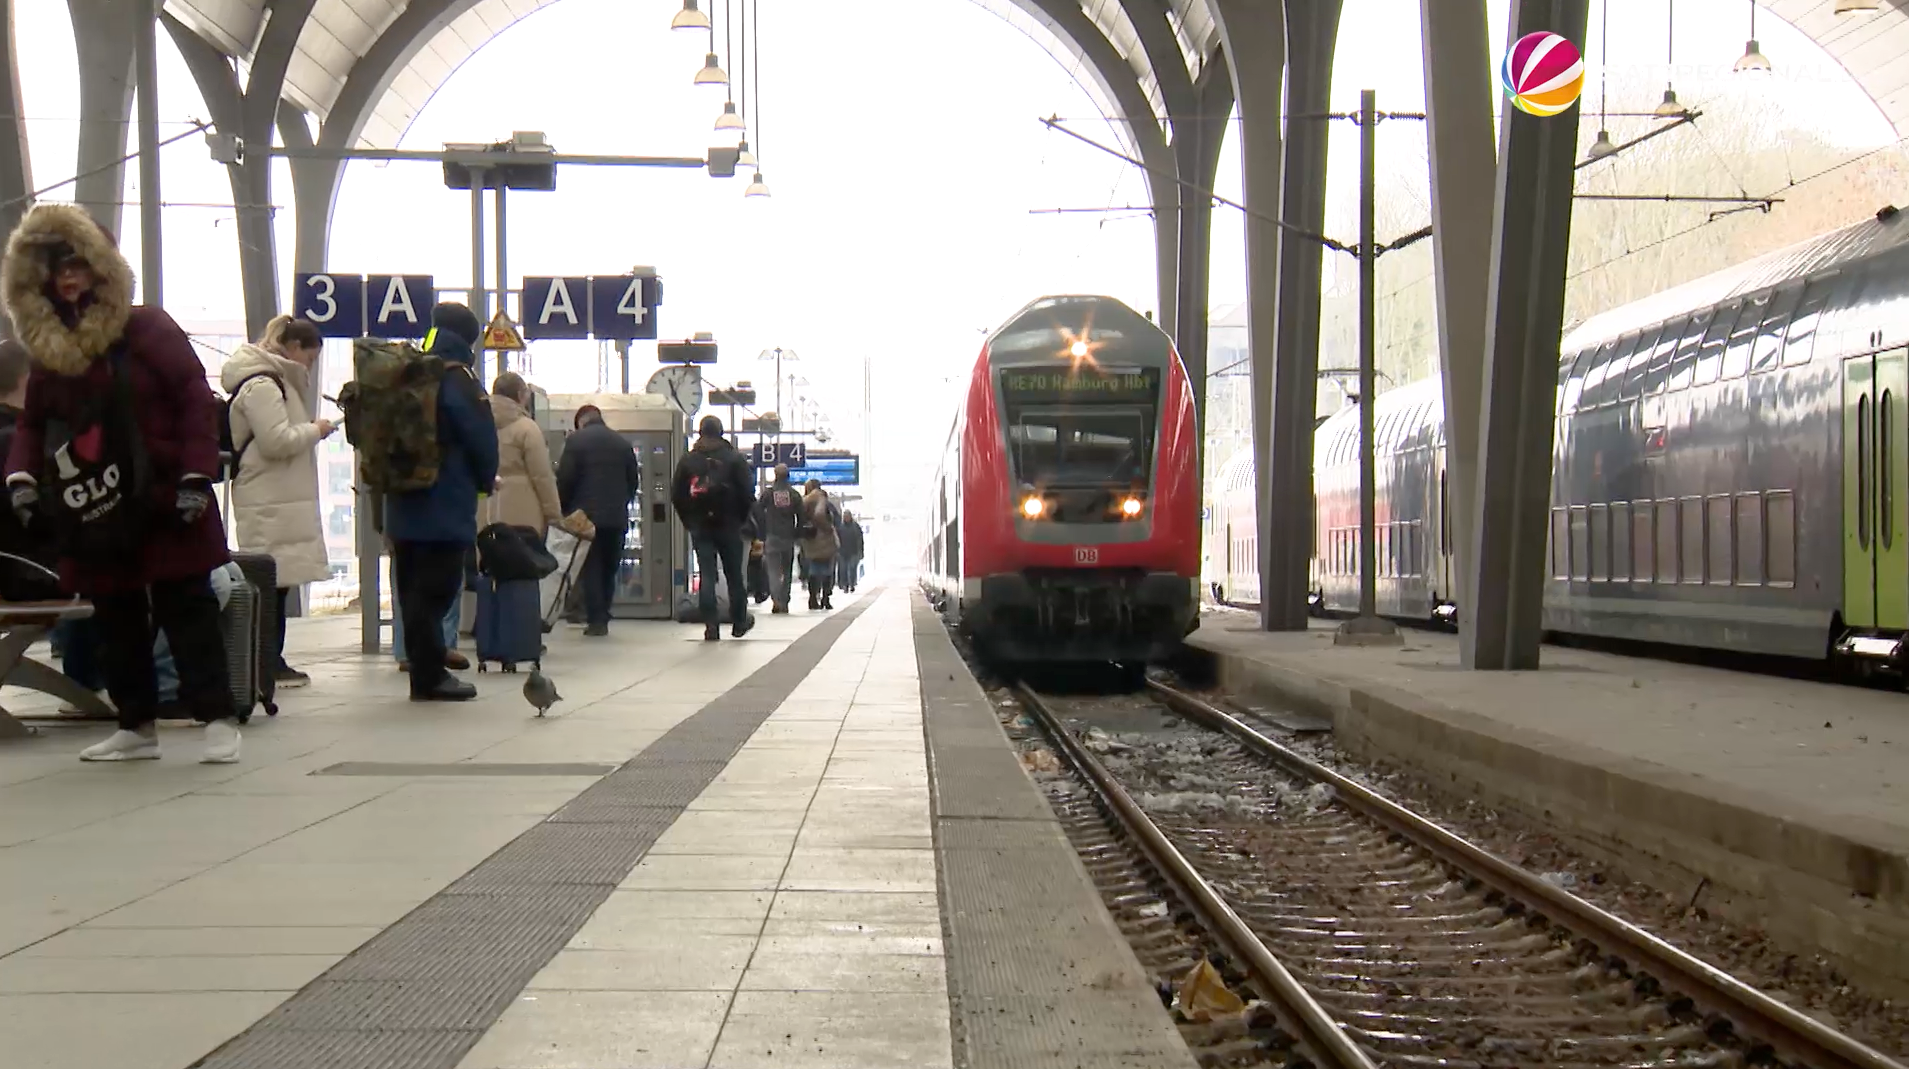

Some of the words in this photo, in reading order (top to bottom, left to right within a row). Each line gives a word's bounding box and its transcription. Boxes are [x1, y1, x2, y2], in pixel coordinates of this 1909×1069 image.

[305, 274, 338, 322] 3
[377, 275, 418, 323] A
[538, 277, 579, 325] A
[616, 277, 648, 325] 4
[1052, 373, 1120, 392] Hamburg
[761, 444, 776, 462] B
[789, 444, 803, 462] 4
[1076, 548, 1097, 563] DB
